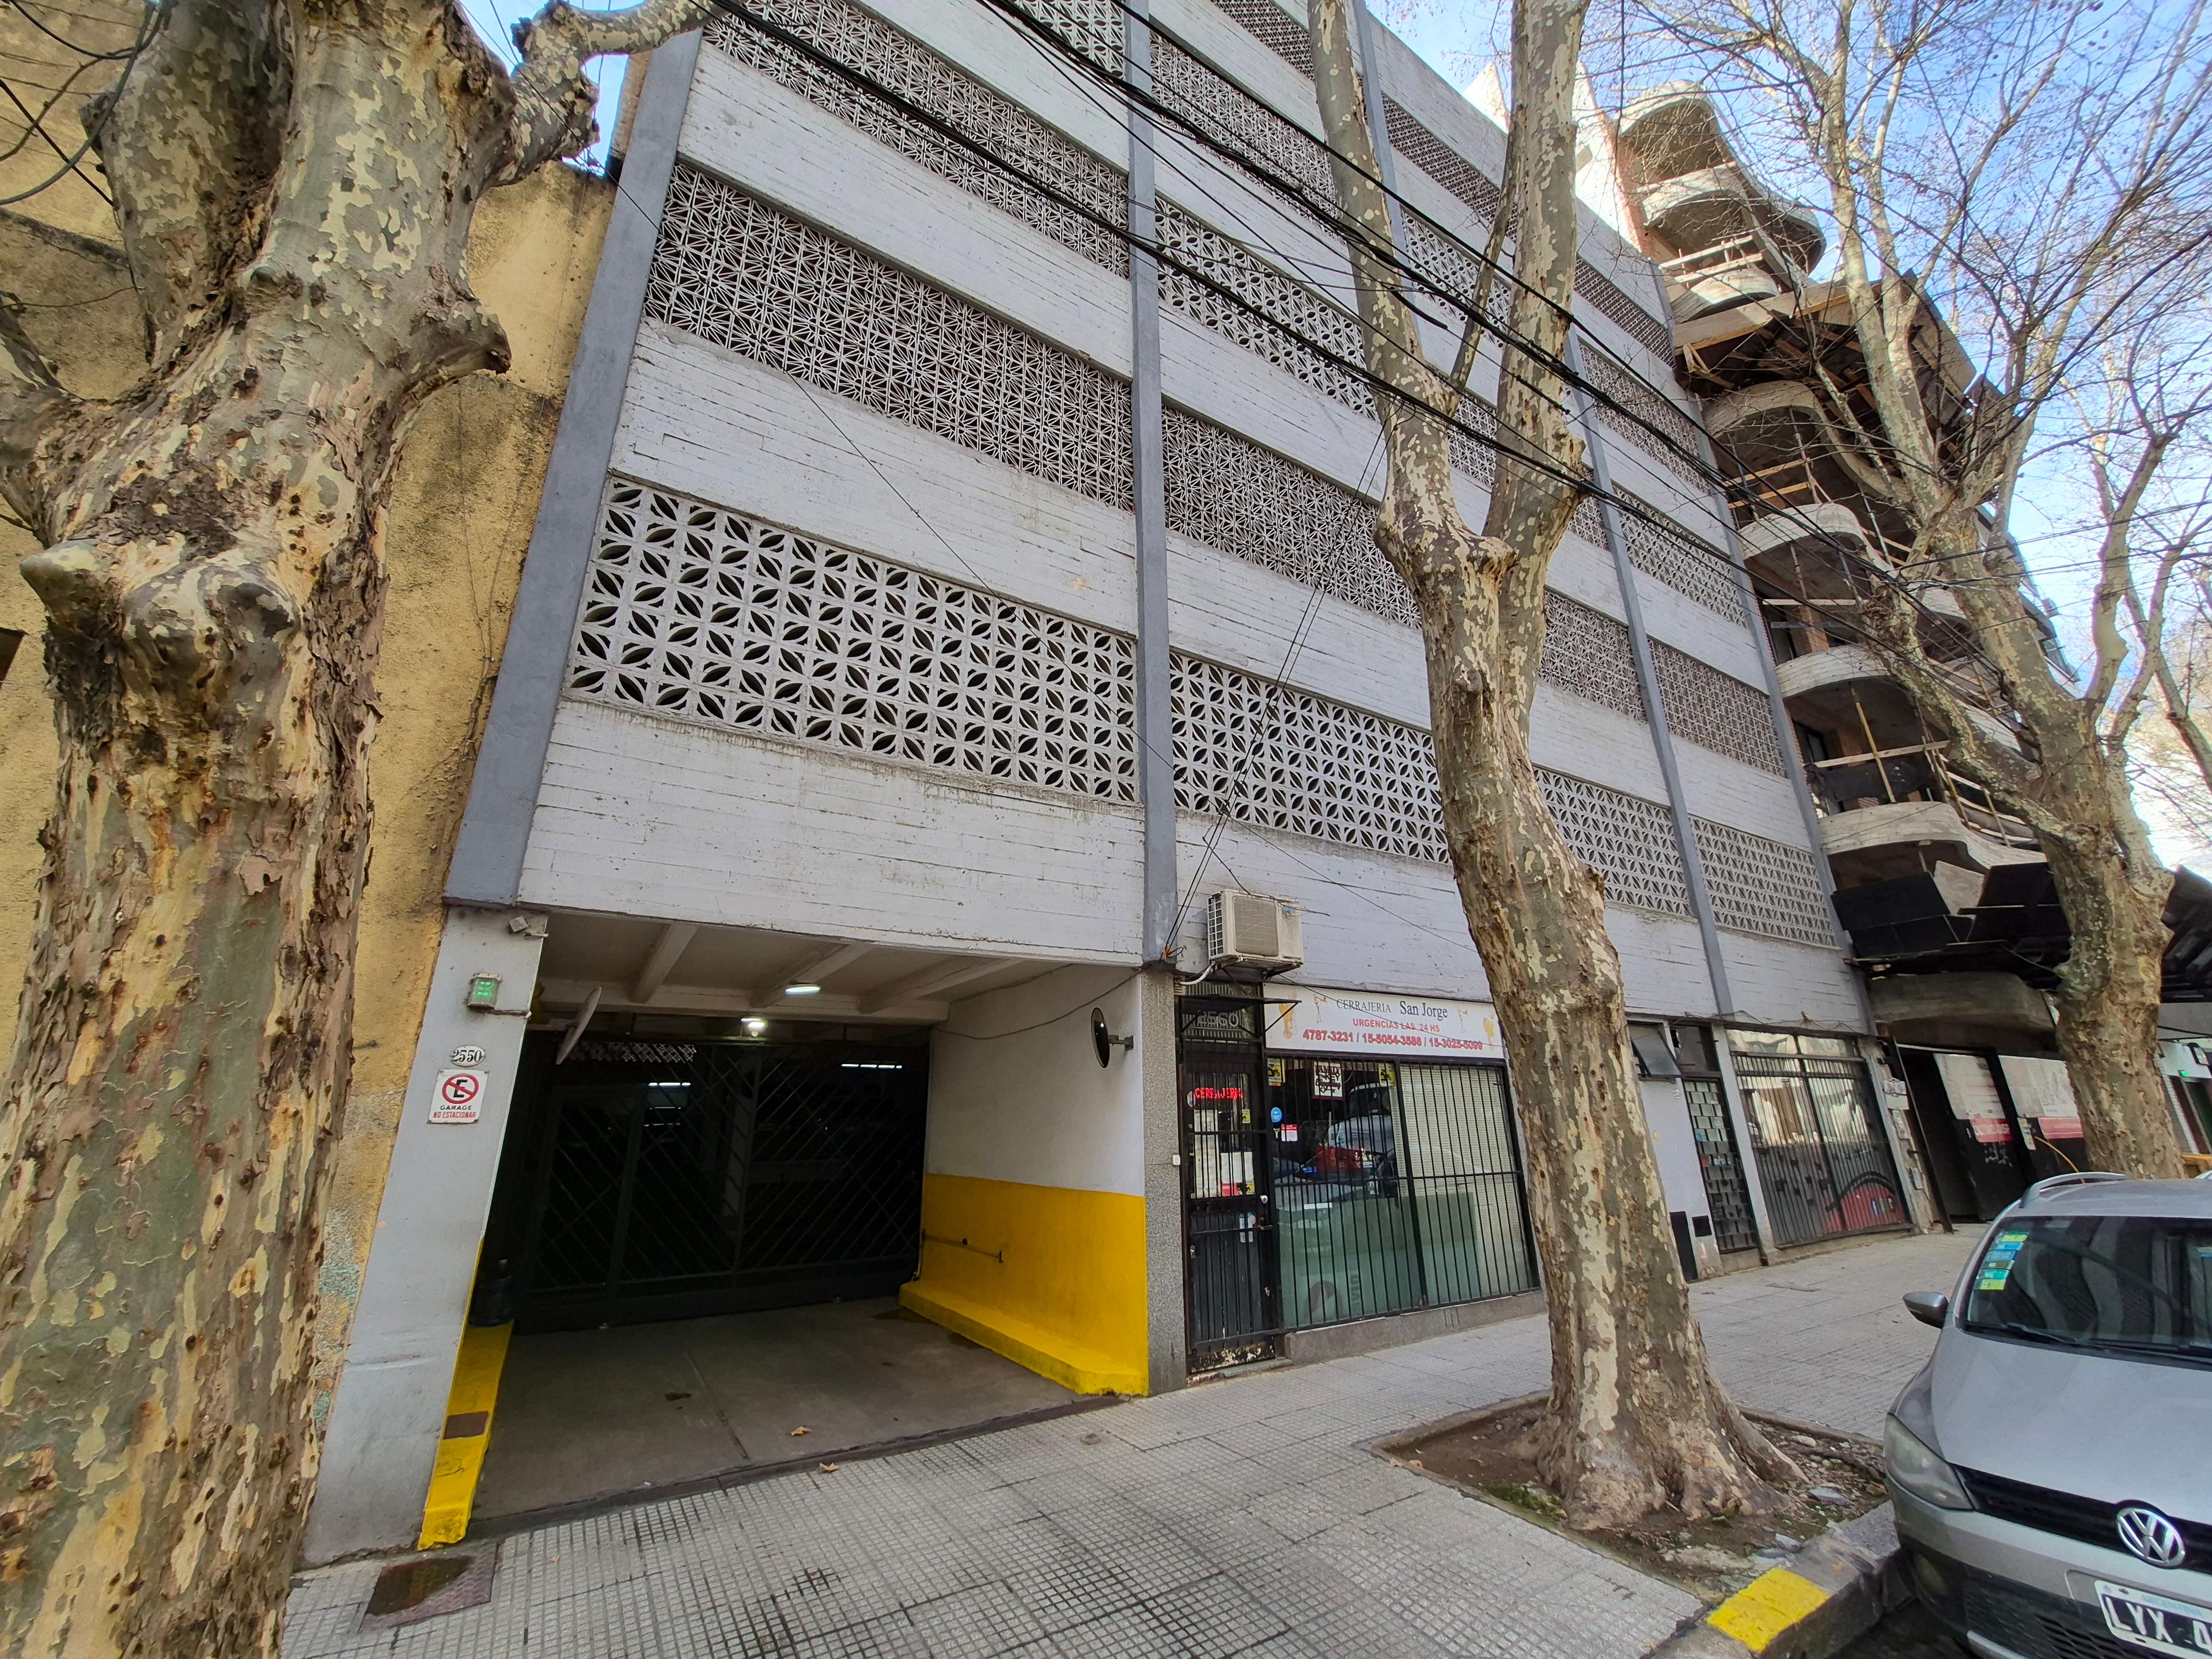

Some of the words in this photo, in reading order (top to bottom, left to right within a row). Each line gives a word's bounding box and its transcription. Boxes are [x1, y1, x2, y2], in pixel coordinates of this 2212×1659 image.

[1336, 999, 1391, 1013] CERRAJERIA
[1400, 1001, 1419, 1016] San
[1422, 1002, 1448, 1021] Jorge
[1197, 1010, 1239, 1027] 2560
[1353, 1018, 1399, 1029] URGENCIAS
[1401, 1022, 1415, 1030] LAS
[1303, 1029, 1353, 1042] 4787-3231
[452, 1049, 482, 1063] 2550
[2105, 1596, 2173, 1644] LYX
